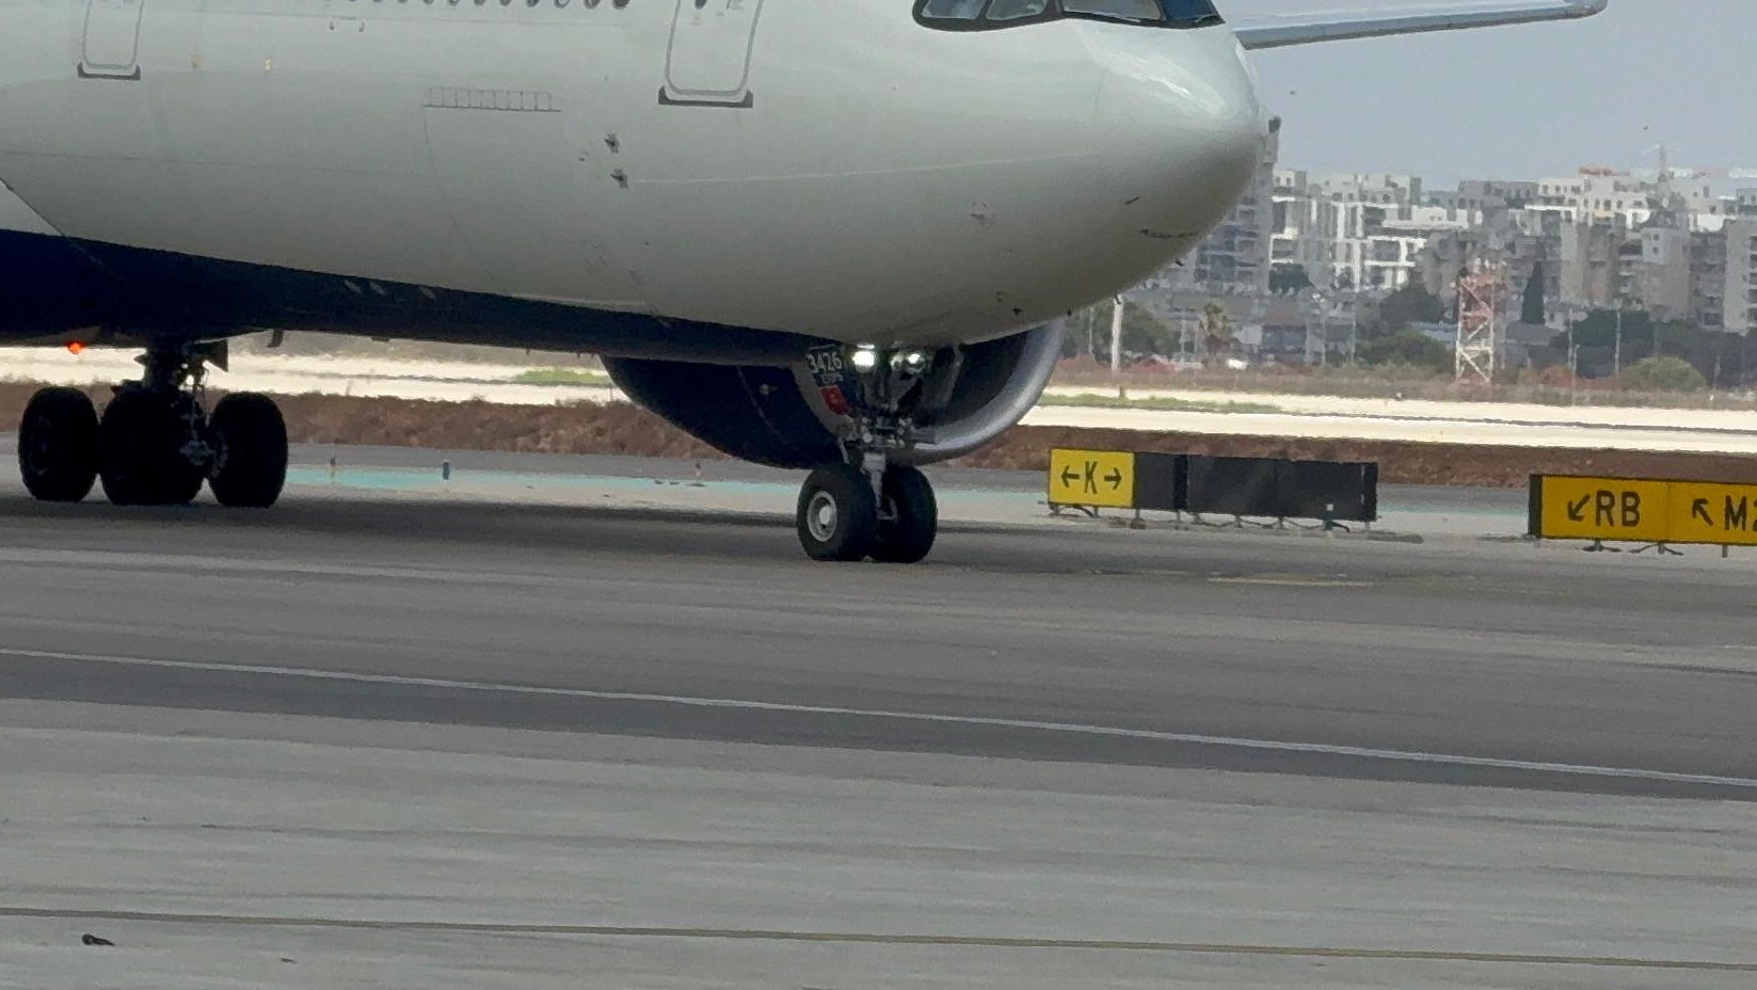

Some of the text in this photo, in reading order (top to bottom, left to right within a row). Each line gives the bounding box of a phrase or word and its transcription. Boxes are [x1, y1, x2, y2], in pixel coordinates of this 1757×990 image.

[805, 351, 844, 374] 3426
[1084, 460, 1098, 495] K
[1595, 489, 1757, 531] RB M
